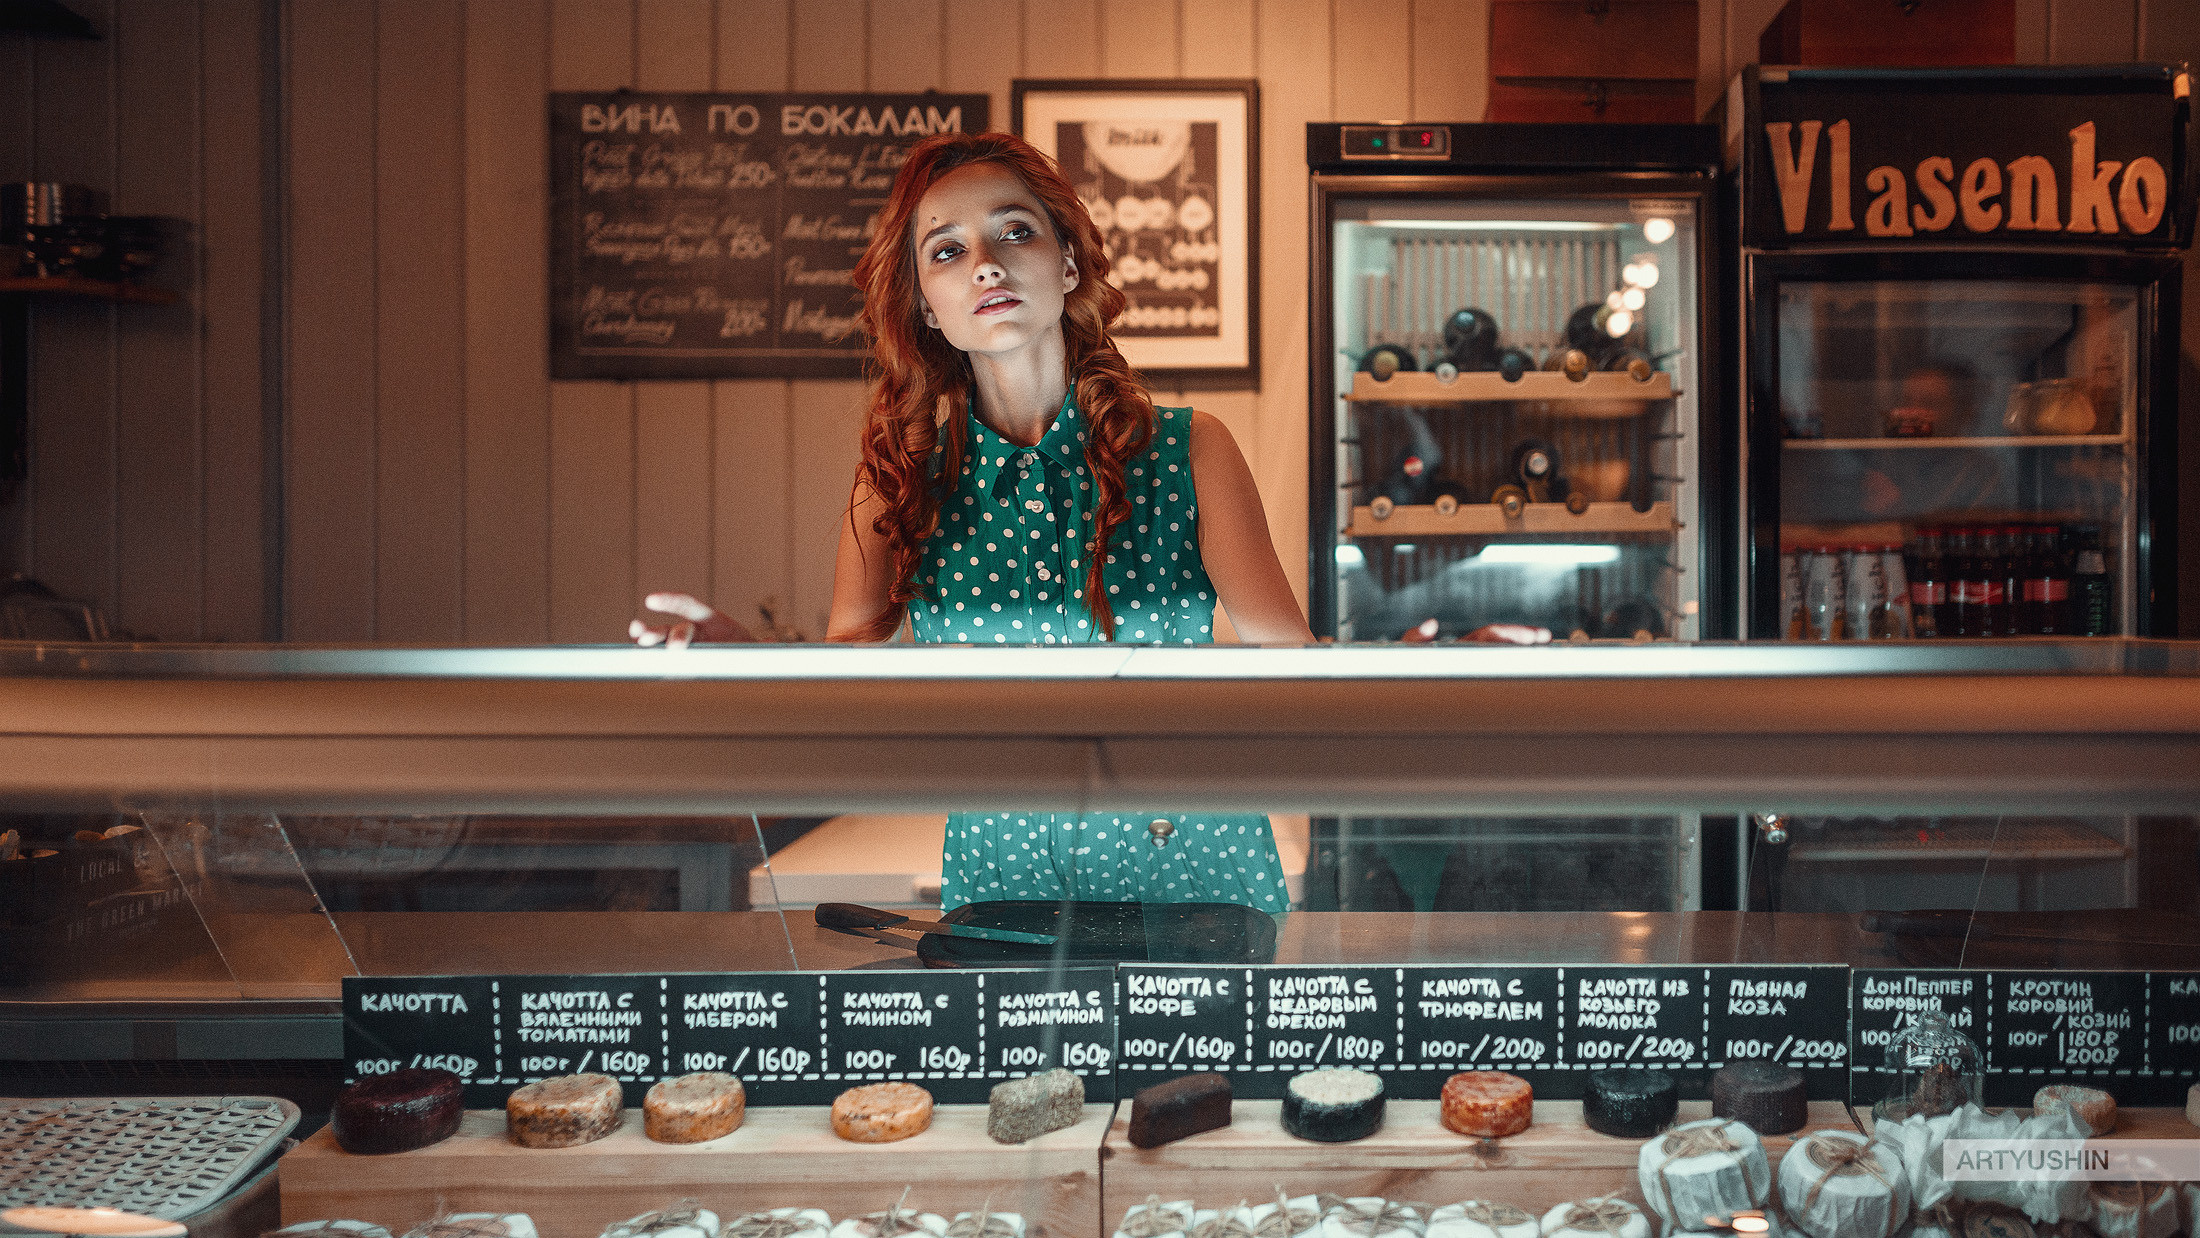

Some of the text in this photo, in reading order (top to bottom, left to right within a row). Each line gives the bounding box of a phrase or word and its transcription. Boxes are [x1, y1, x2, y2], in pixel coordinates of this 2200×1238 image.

[581, 104, 963, 136] ВИНА ПО БОКАЛАМ
[1765, 118, 2167, 237] Vlasenko
[80, 856, 122, 884] LOCAL
[1128, 976, 1212, 997] КАЧОТТА
[1270, 977, 1350, 998] КАЧОТТА
[1422, 978, 1500, 998] КАЧОТТА
[1579, 978, 1689, 997] КАЧОТТА ИЗ
[1729, 979, 1807, 999] ПЬЯНАЯ
[2009, 981, 2092, 997] КРОТИН
[2169, 979, 2200, 995] КА
[361, 993, 468, 1013] КАЧОТТА
[521, 991, 611, 1011] КАЧОТТА
[683, 991, 767, 1011] КАЧОТТА
[843, 992, 923, 1009] КАЧОТТА
[999, 990, 1080, 1009] КАЧОТТА
[1129, 999, 1197, 1017] КОФЕ
[1269, 996, 1377, 1014] КЕДРОВЫМ
[1578, 997, 1661, 1015] КОЗЬЕГО
[1728, 999, 1787, 1016] КОЗА
[1862, 996, 1942, 1011] КОРОВИЙ
[2007, 998, 2094, 1014] КОРОВИЙ
[684, 1011, 777, 1029] ЧАБЕРОМ
[842, 1010, 932, 1027] ТМИНОМ
[1418, 1001, 1543, 1021] ТРЮФЕЛЕМ
[1267, 1014, 1346, 1030] ОРЕХОМ
[1577, 1013, 1657, 1030] МОЛОКА
[517, 1028, 630, 1044] ТОМАТАМИ
[2008, 1031, 2049, 1046] 100г
[521, 1056, 570, 1072] 100г
[684, 1052, 727, 1070] 100г
[845, 1051, 897, 1070] 100г
[1002, 1046, 1047, 1067] 100г
